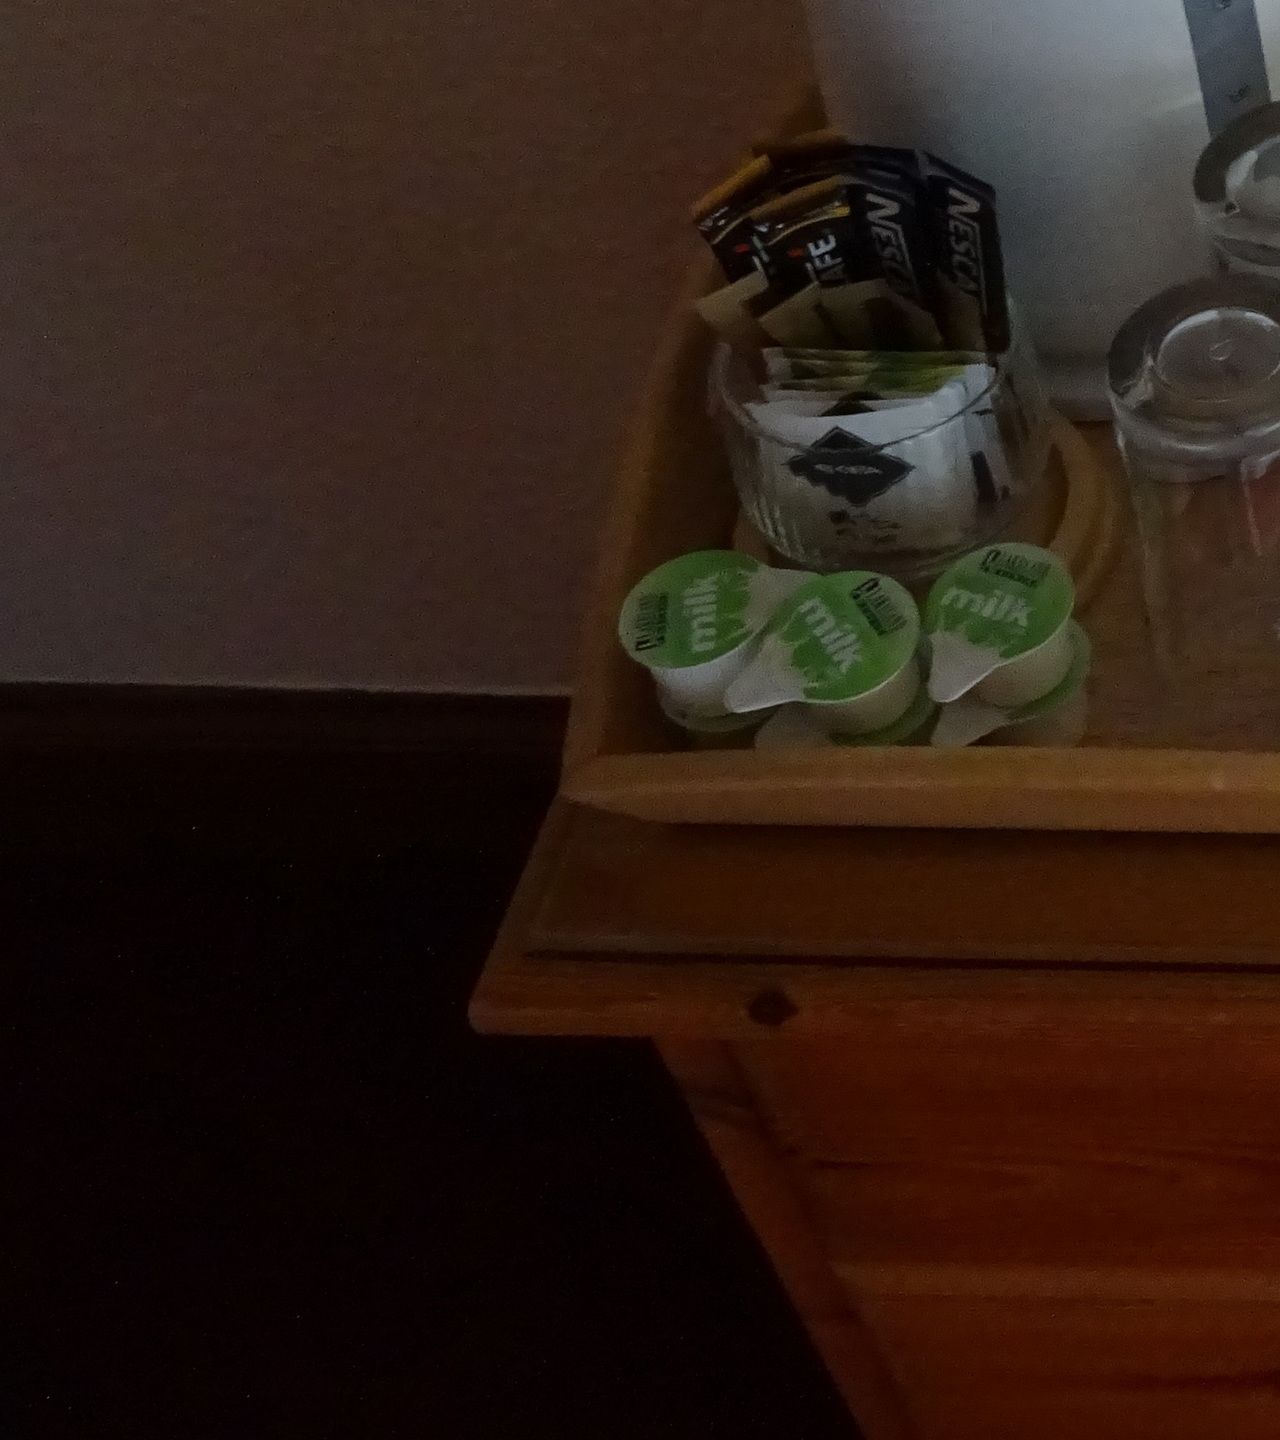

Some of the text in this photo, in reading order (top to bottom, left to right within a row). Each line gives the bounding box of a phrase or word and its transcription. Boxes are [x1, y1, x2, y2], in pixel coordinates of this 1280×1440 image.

[682, 576, 719, 653] milk
[798, 597, 862, 675] milk
[940, 587, 1031, 627] milk
